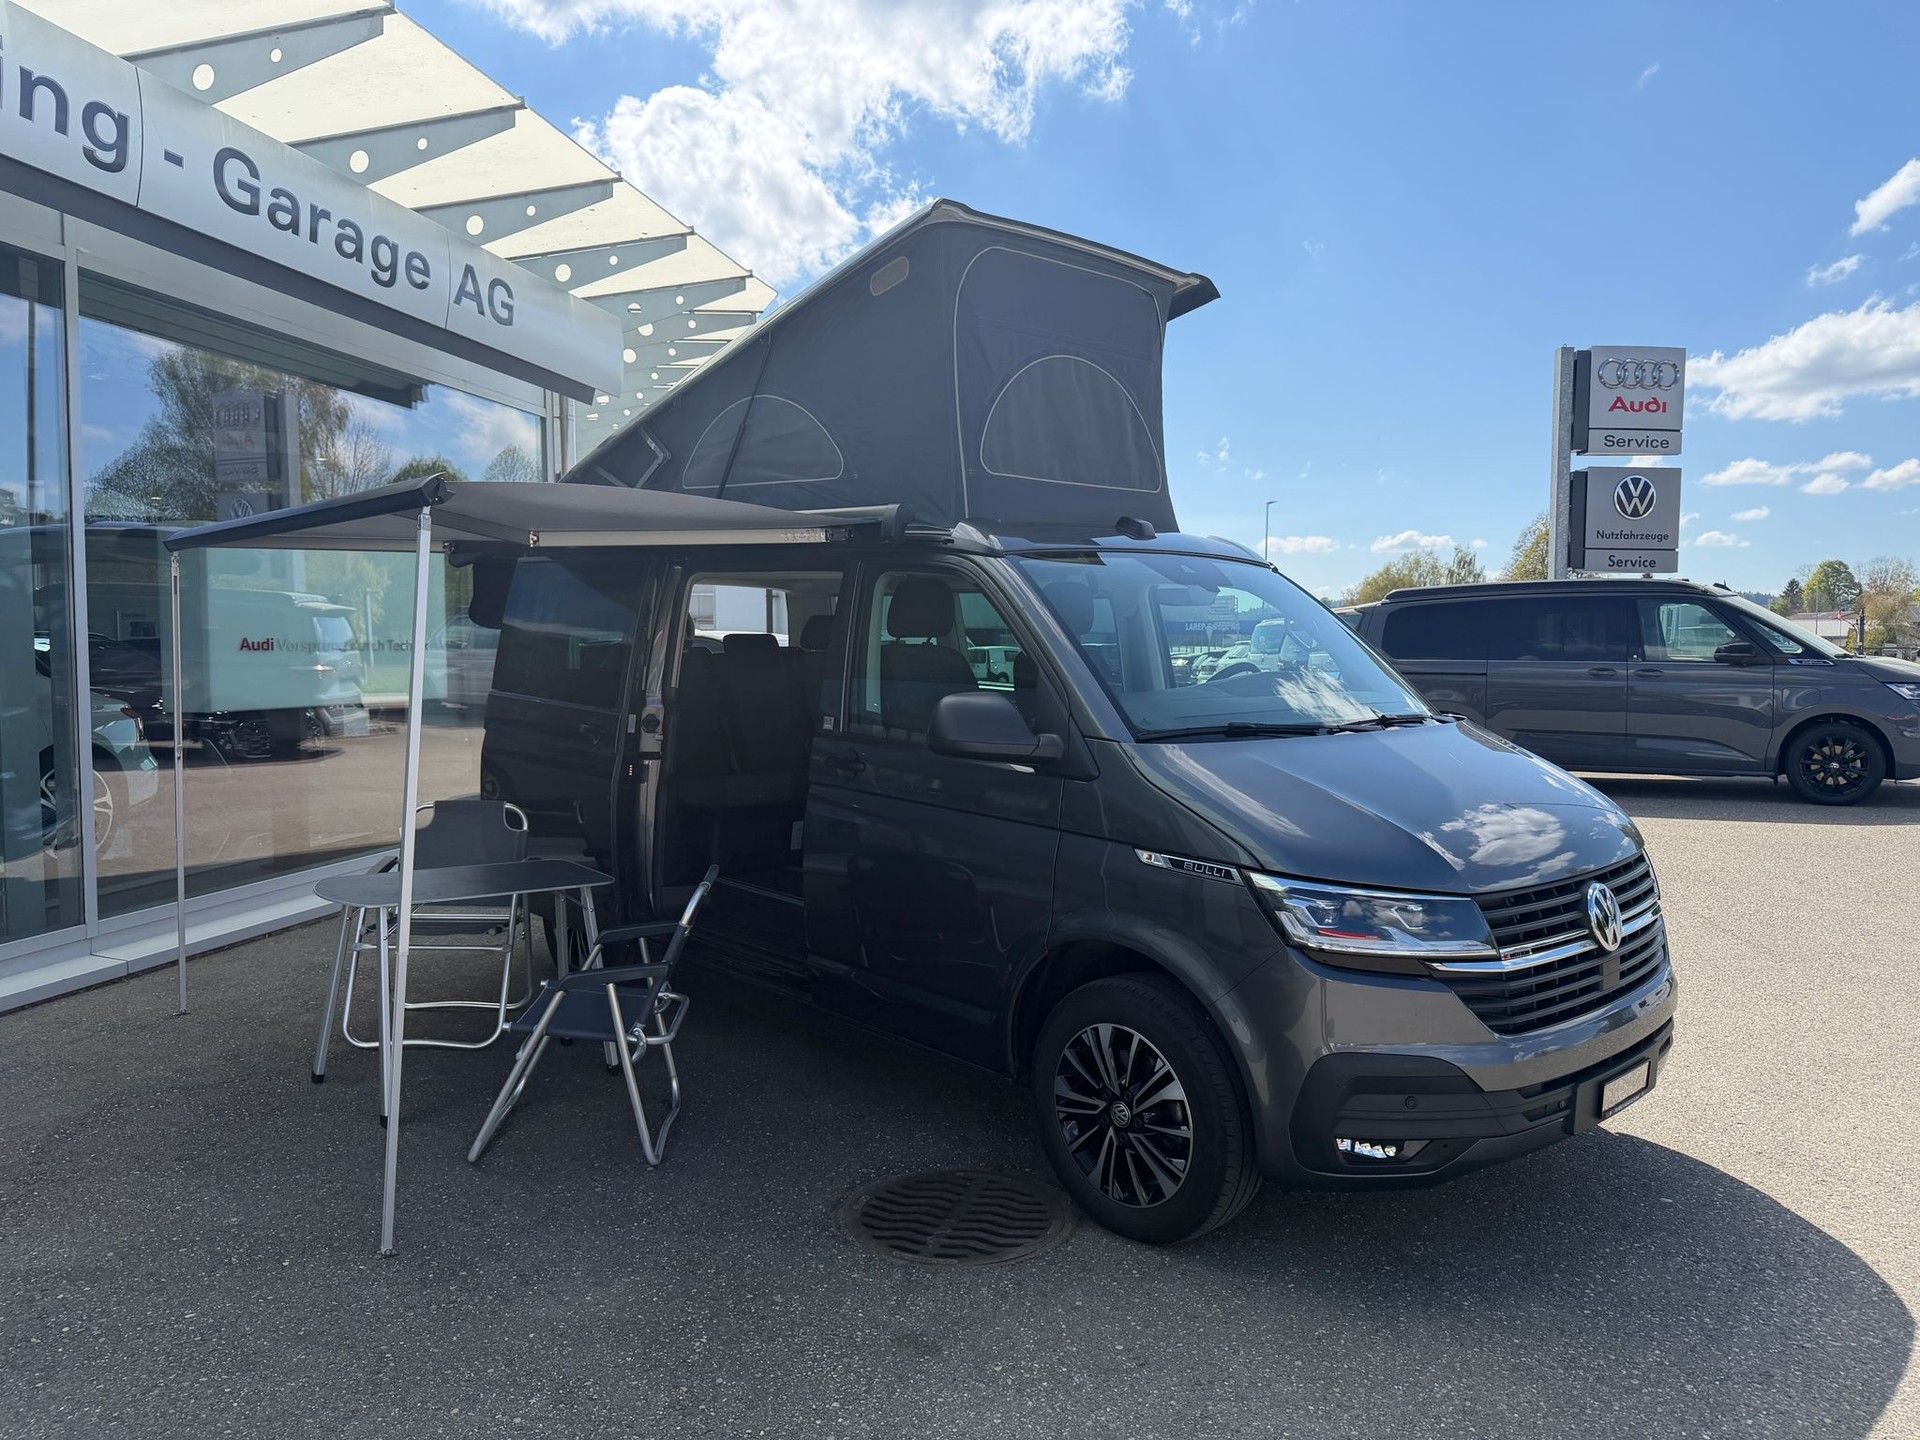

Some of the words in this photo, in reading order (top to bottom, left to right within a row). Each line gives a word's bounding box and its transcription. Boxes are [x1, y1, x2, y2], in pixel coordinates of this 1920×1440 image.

[0, 35, 131, 174] ng
[213, 147, 431, 291] Garage
[453, 263, 515, 327] AG
[1608, 395, 1667, 413] Audi
[1603, 434, 1669, 448] Service
[1596, 530, 1669, 542] Nutzfahrzeuge
[1608, 554, 1656, 568] Service
[239, 637, 275, 652] Audi
[387, 638, 429, 651] Techk
[1183, 861, 1225, 878] BULLI
